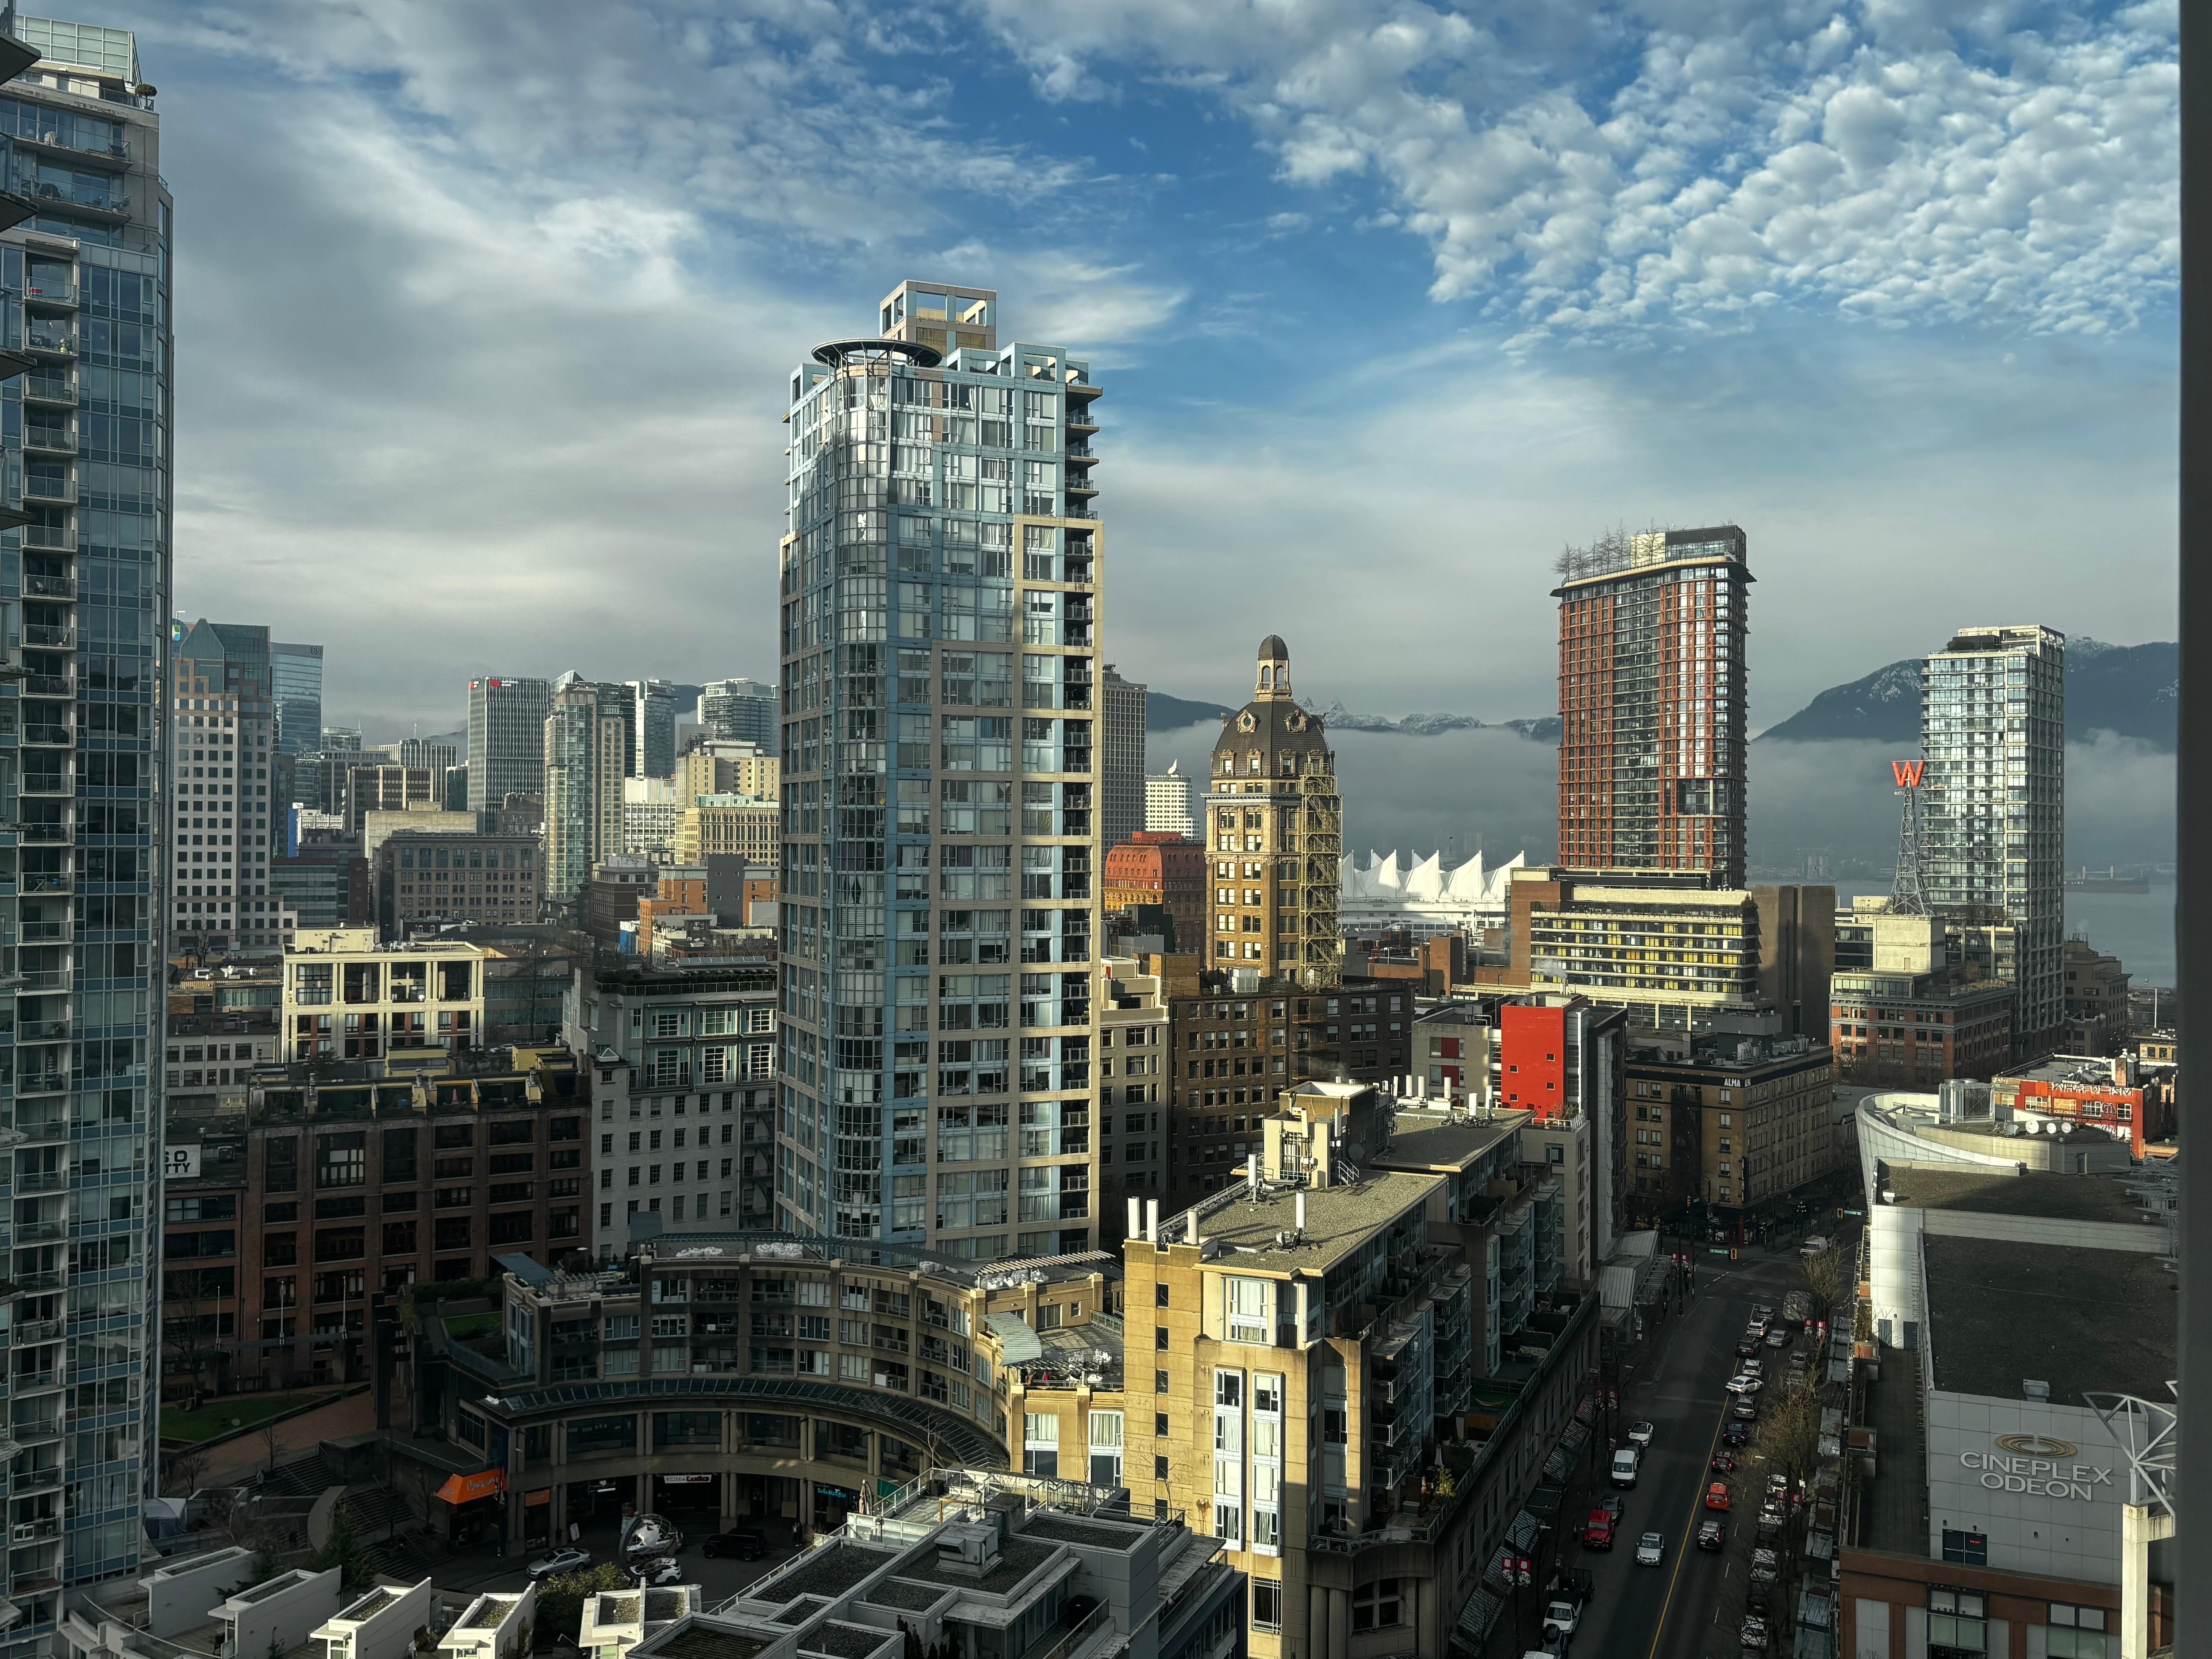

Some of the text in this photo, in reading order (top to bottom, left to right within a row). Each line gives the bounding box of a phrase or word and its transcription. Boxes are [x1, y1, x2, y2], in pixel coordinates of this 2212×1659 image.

[1892, 761, 1924, 787] W
[1724, 1078, 1741, 1087] ALMA
[1960, 1451, 2113, 1486] CINEPLEX
[1980, 1472, 2092, 1501] ODEON
